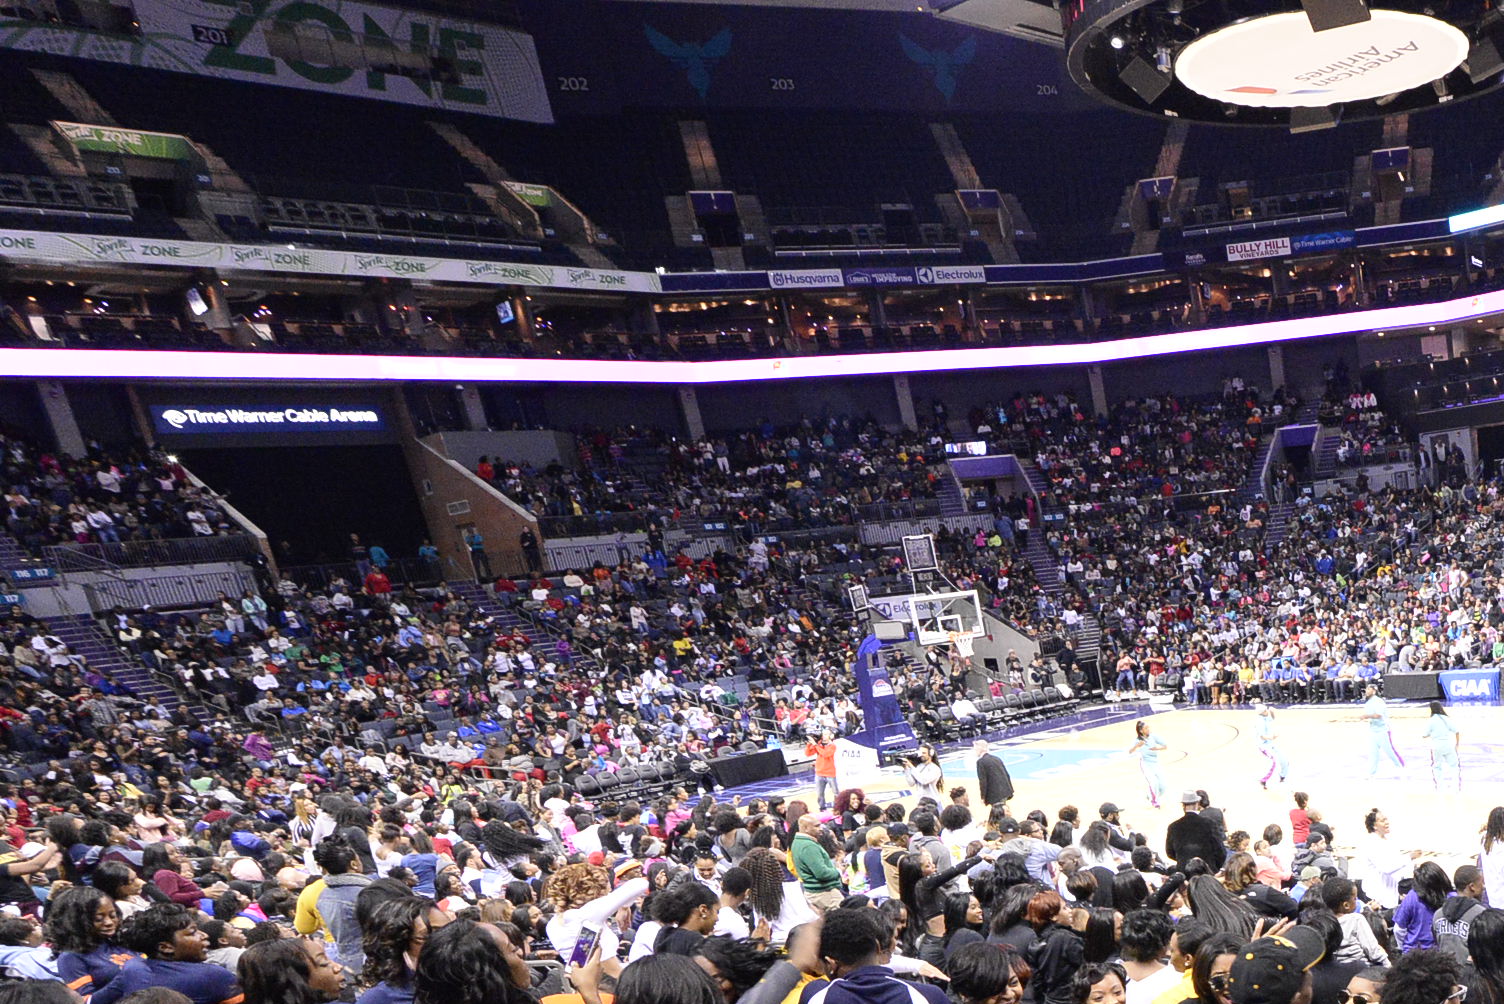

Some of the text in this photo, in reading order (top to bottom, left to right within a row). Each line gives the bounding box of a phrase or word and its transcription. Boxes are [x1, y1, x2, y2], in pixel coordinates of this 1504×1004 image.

[198, 25, 229, 46] 201
[202, 0, 488, 106] ZONE
[1294, 44, 1382, 82] Airlines
[1311, 39, 1420, 87] American
[558, 76, 590, 92] 202
[770, 78, 796, 91] 203
[1036, 84, 1059, 96] 204
[101, 130, 143, 146] ZONE
[1227, 240, 1289, 255] BULLY HILL
[1239, 249, 1280, 259] VINEYARDS
[0, 236, 36, 250] ONE
[141, 244, 182, 258] ZONE
[273, 253, 311, 266] ZONE
[394, 261, 426, 274] ZONE
[501, 267, 532, 279] ZONE
[599, 274, 627, 286] ZONE
[784, 273, 841, 286] Husqvarna
[936, 270, 984, 280] Electrolux
[183, 408, 379, 424] Time Warner Cable Arena
[15, 568, 49, 578] 116 117
[893, 602, 938, 613] Elecrolux
[1450, 679, 1491, 697] CIAA
